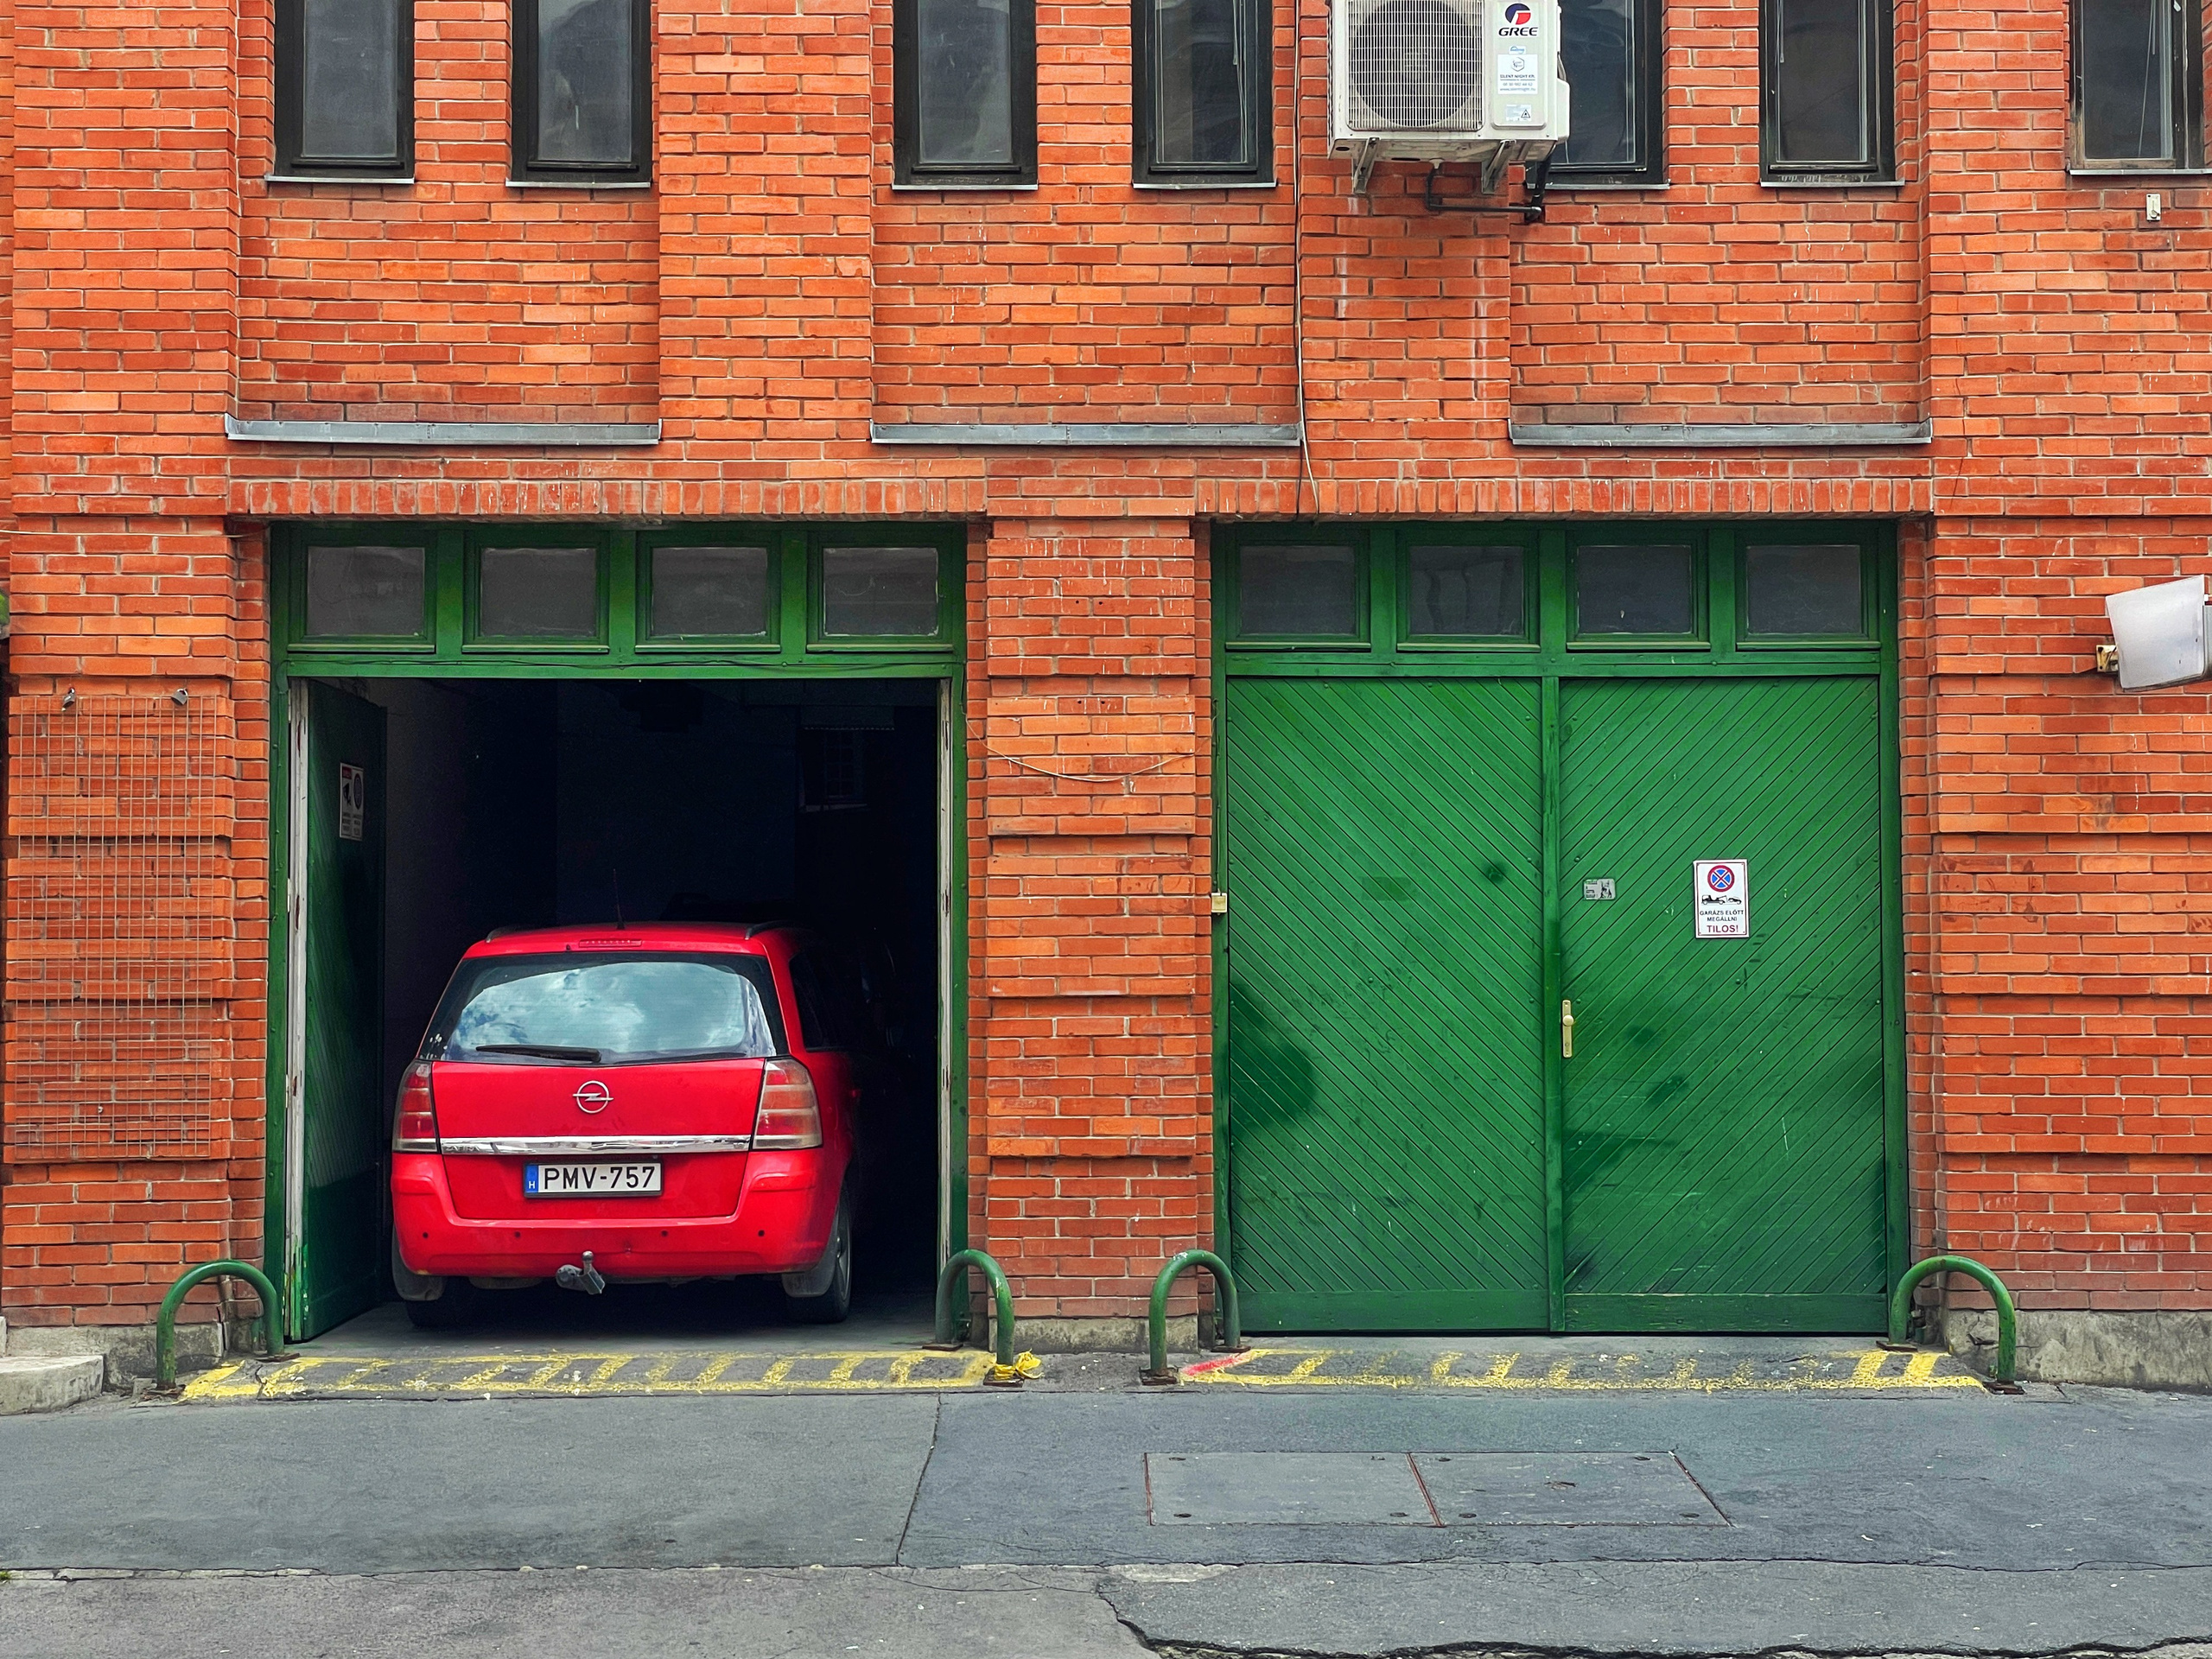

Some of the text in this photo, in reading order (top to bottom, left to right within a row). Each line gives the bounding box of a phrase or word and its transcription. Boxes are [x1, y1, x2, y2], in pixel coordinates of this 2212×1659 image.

[1498, 27, 1538, 36] GREE
[1707, 925, 1738, 933] TILOS!
[529, 1166, 655, 1190] H PMV-757
